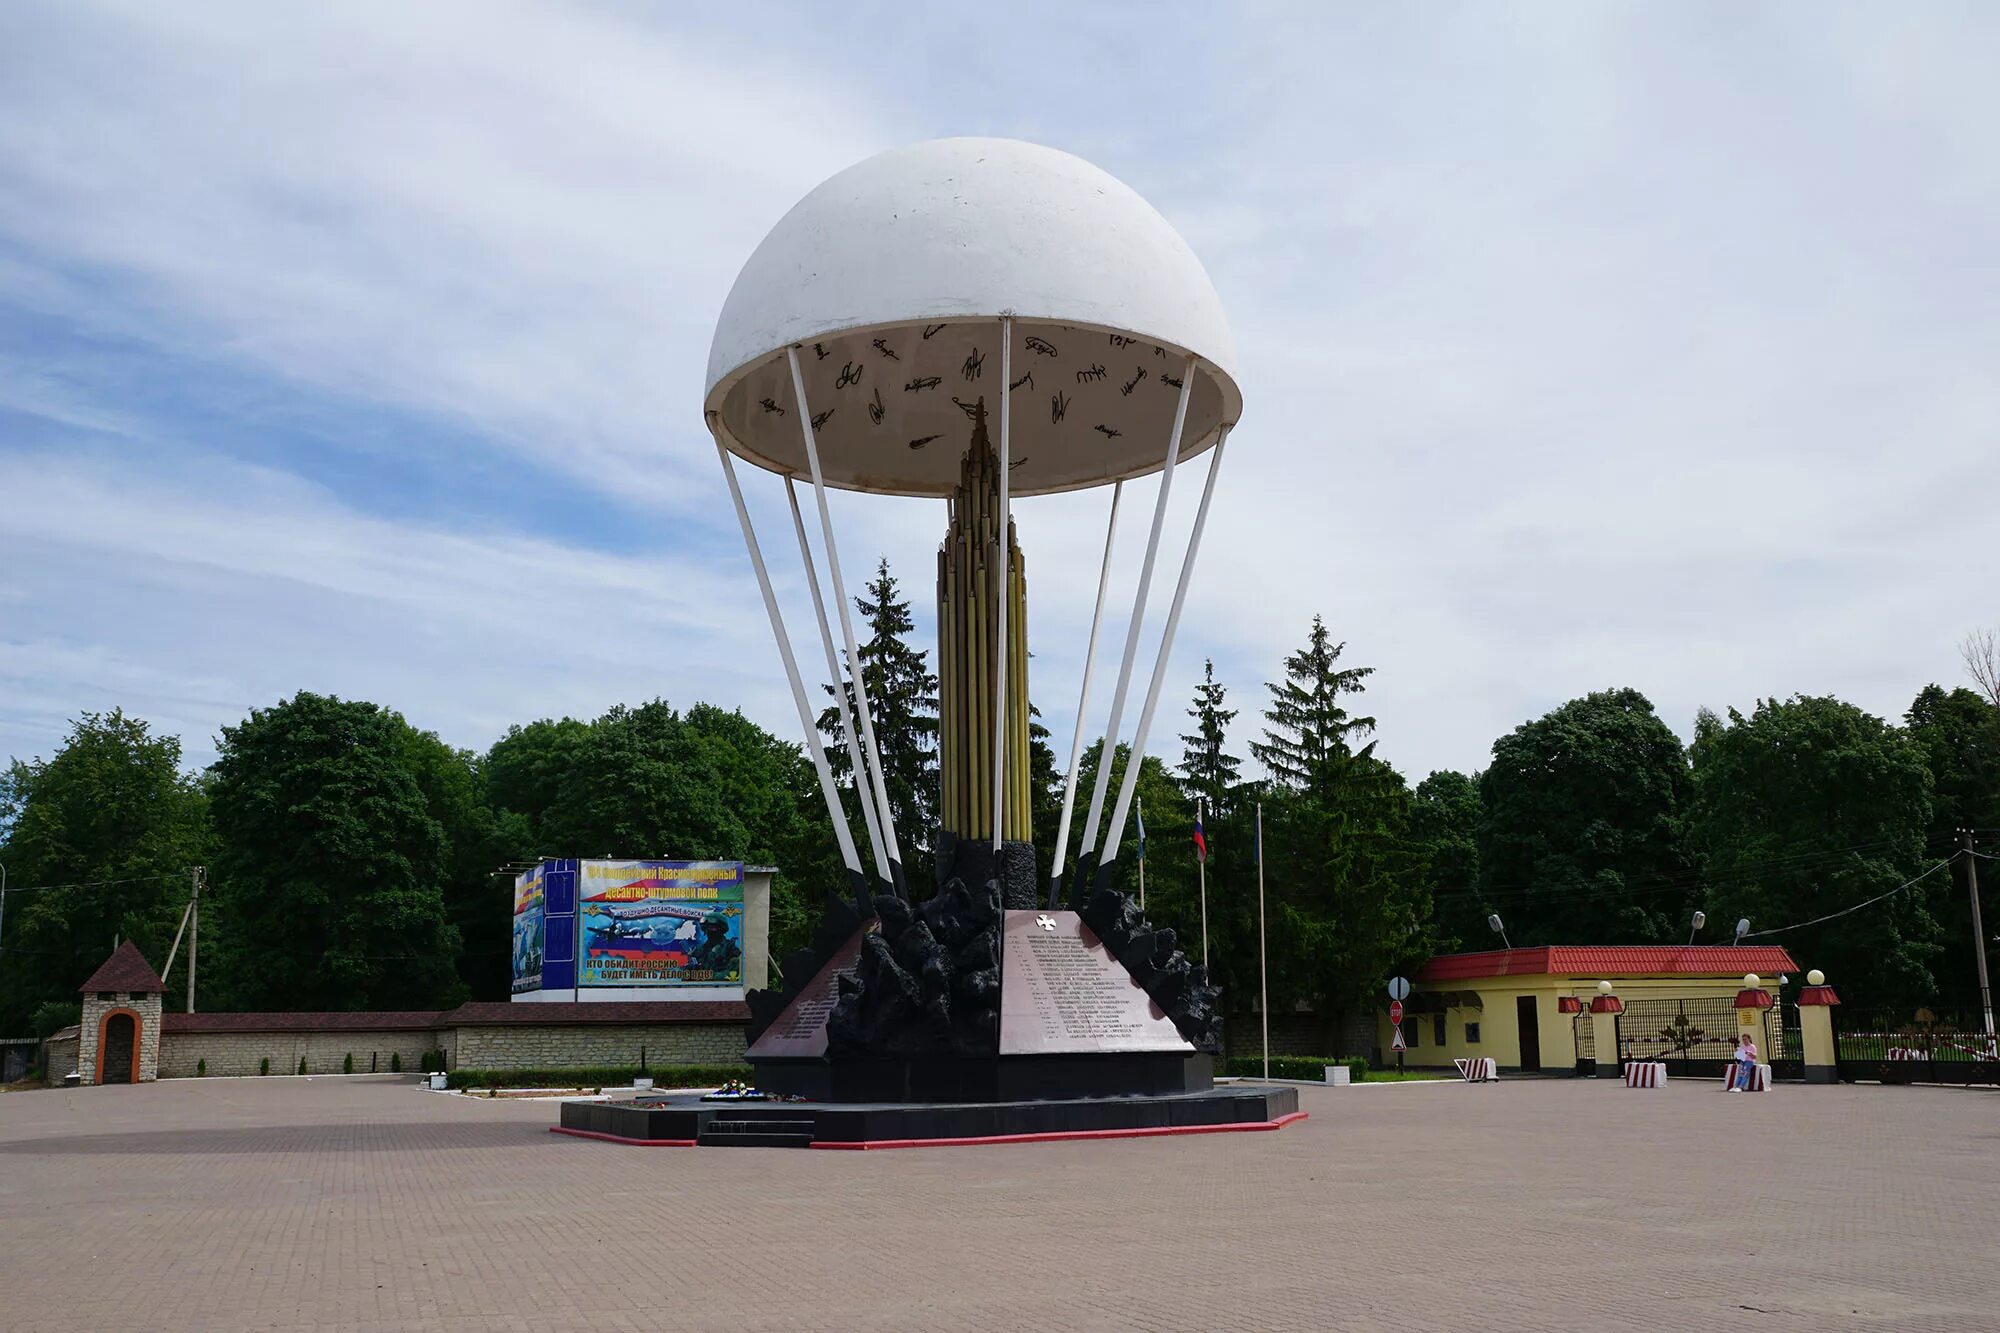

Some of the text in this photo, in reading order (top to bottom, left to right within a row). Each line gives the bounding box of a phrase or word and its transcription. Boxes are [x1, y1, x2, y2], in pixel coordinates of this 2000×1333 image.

[697, 887, 718, 899] полк
[586, 960, 678, 969] КТО ОБИДИТ РОССИЮ
[601, 970, 627, 979] БУДЕТ
[629, 970, 658, 979] ИМЕТЬ
[659, 970, 682, 980] ДЕЛО
[684, 970, 690, 980] С
